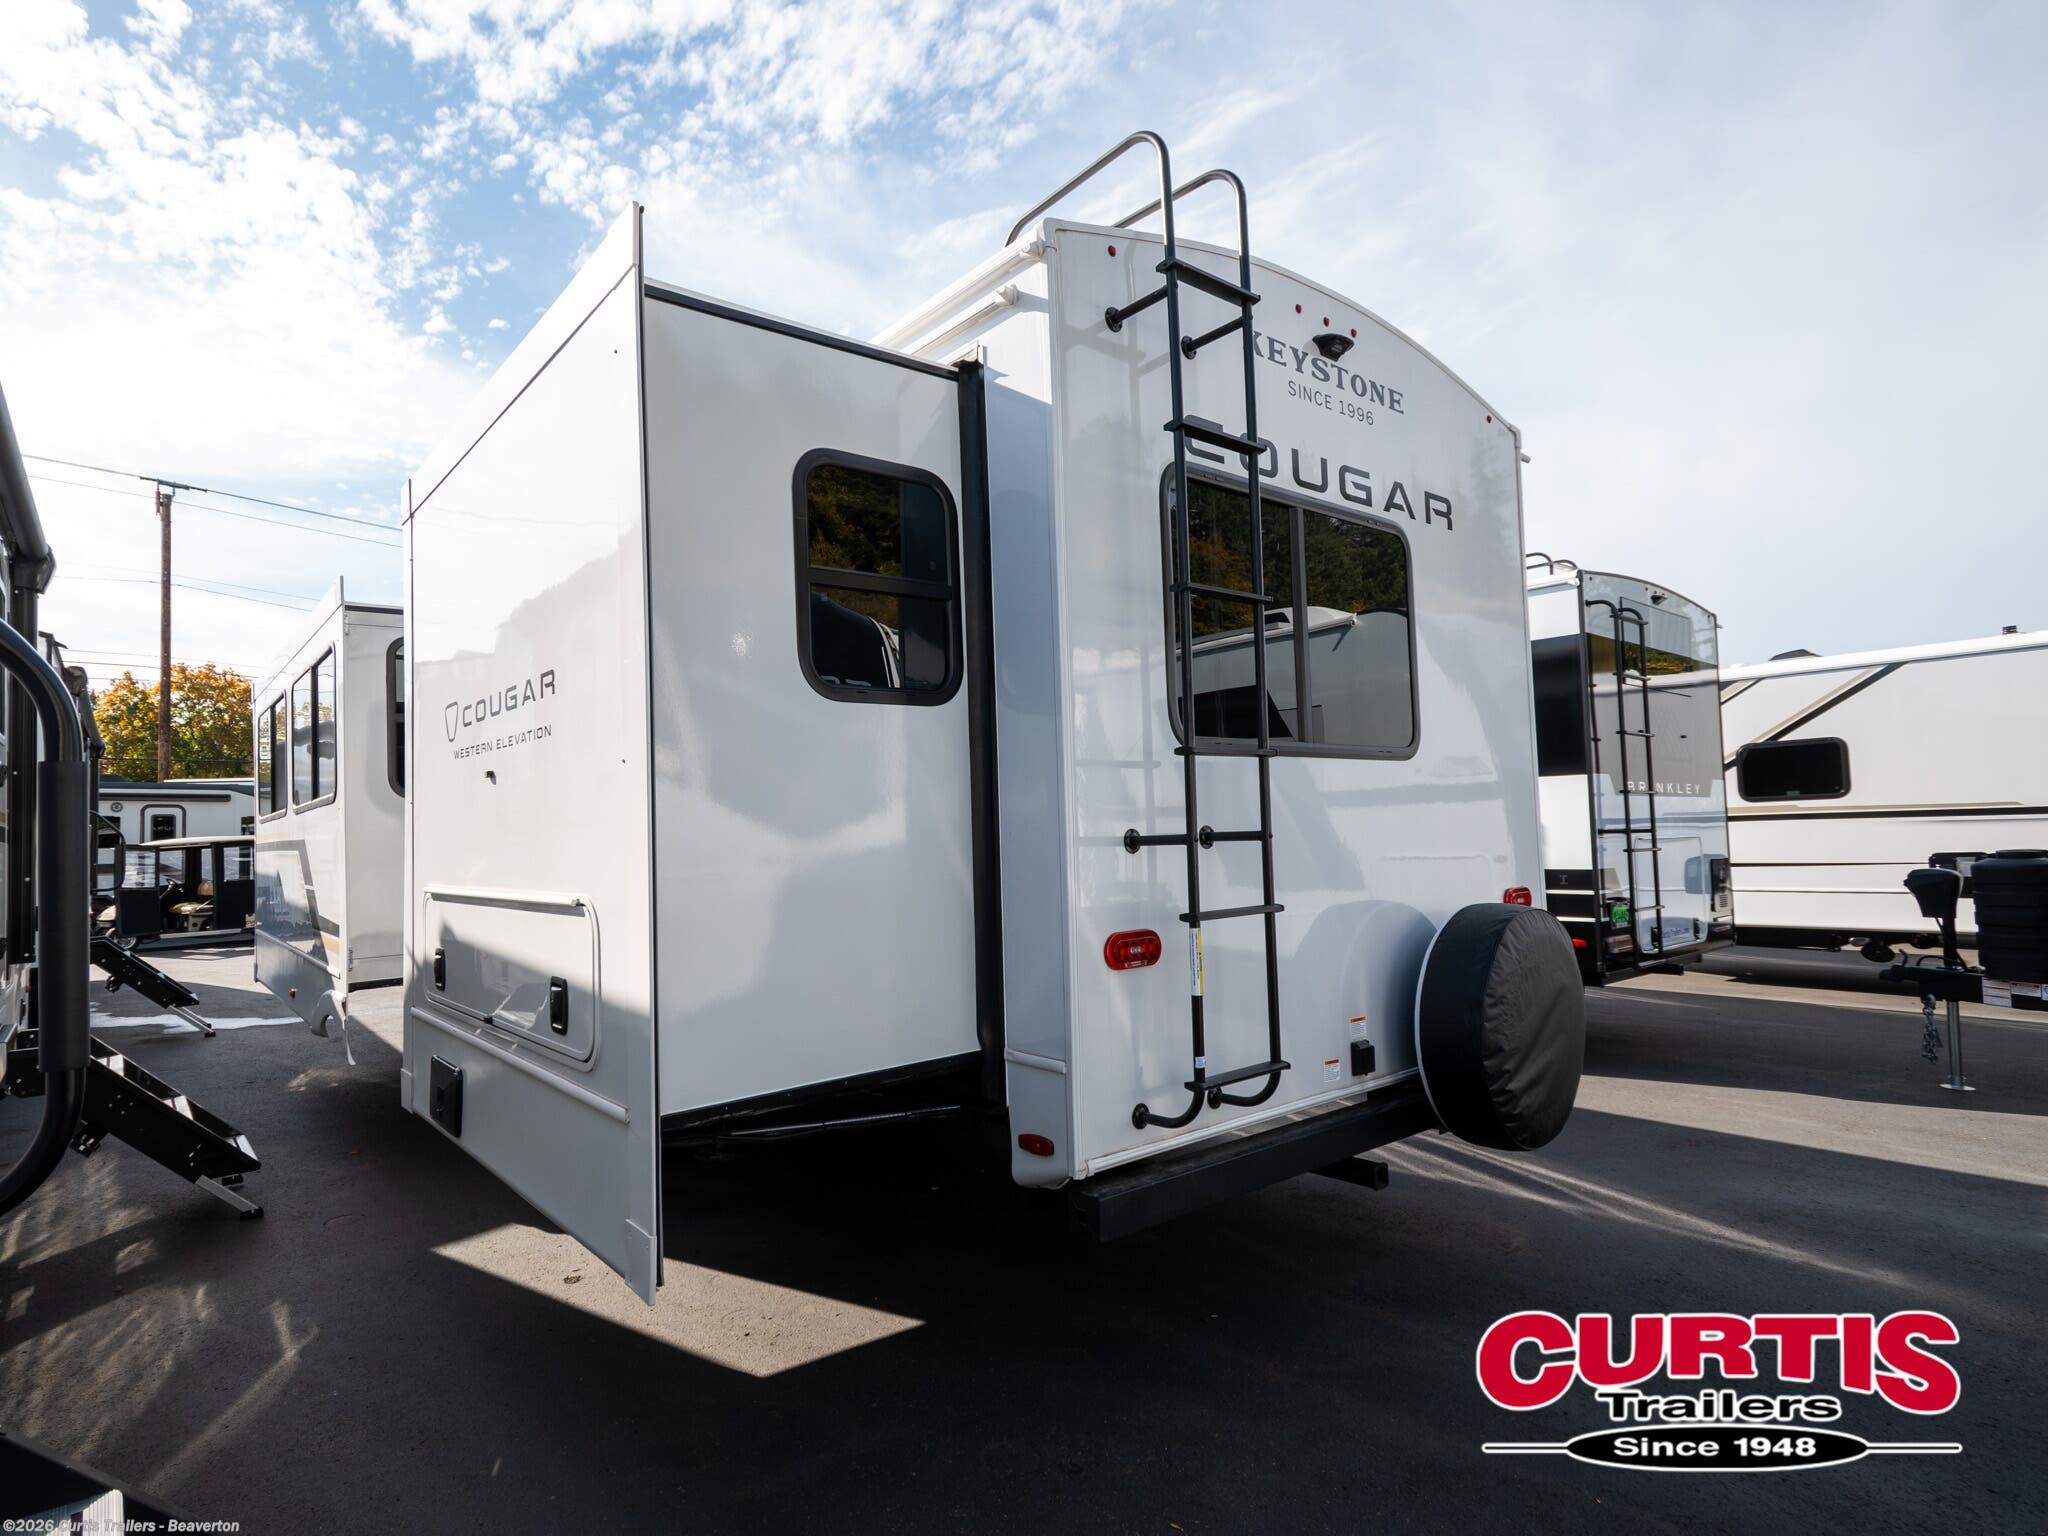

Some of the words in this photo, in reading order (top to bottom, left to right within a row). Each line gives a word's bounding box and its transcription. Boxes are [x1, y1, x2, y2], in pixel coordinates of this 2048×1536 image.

[1287, 380, 1333, 411] SINCE
[1338, 400, 1375, 426] 1996
[462, 669, 556, 727] COUGAR
[454, 741, 493, 759] WESTERN
[496, 724, 552, 750] ELEVATION
[1626, 780, 1701, 795] BRNKLEY
